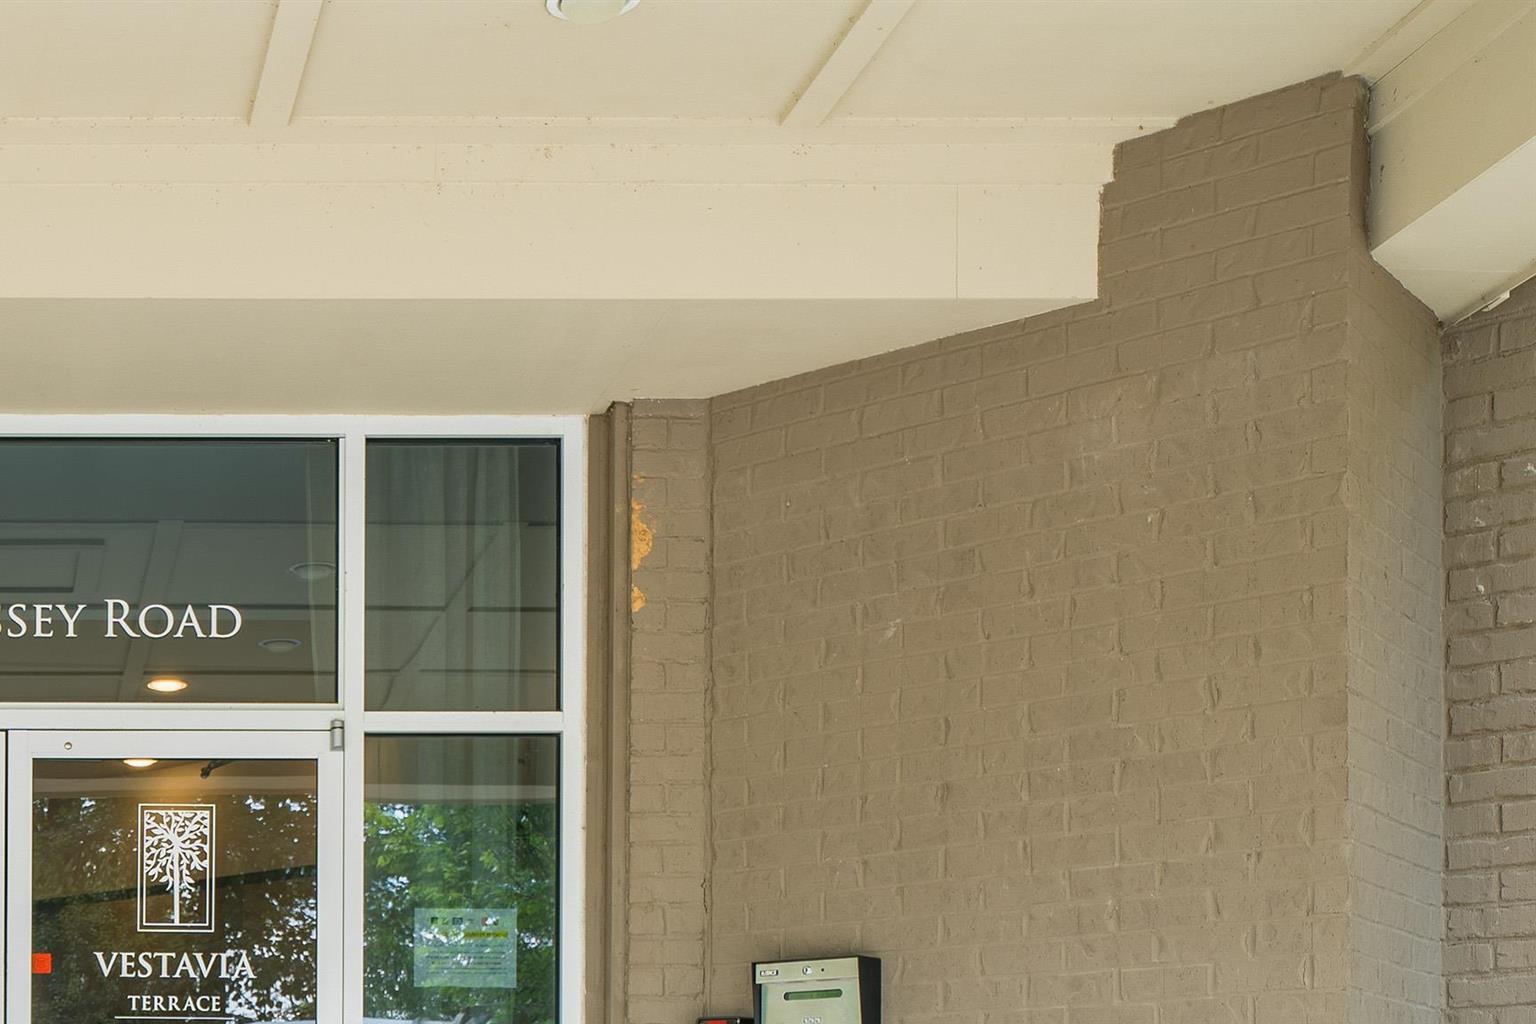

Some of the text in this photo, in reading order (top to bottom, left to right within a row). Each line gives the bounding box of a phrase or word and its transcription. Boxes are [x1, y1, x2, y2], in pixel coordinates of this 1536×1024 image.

[103, 598, 242, 638] ROAD
[93, 951, 257, 980] VESTAVIA
[127, 994, 222, 1012] TERRACE
